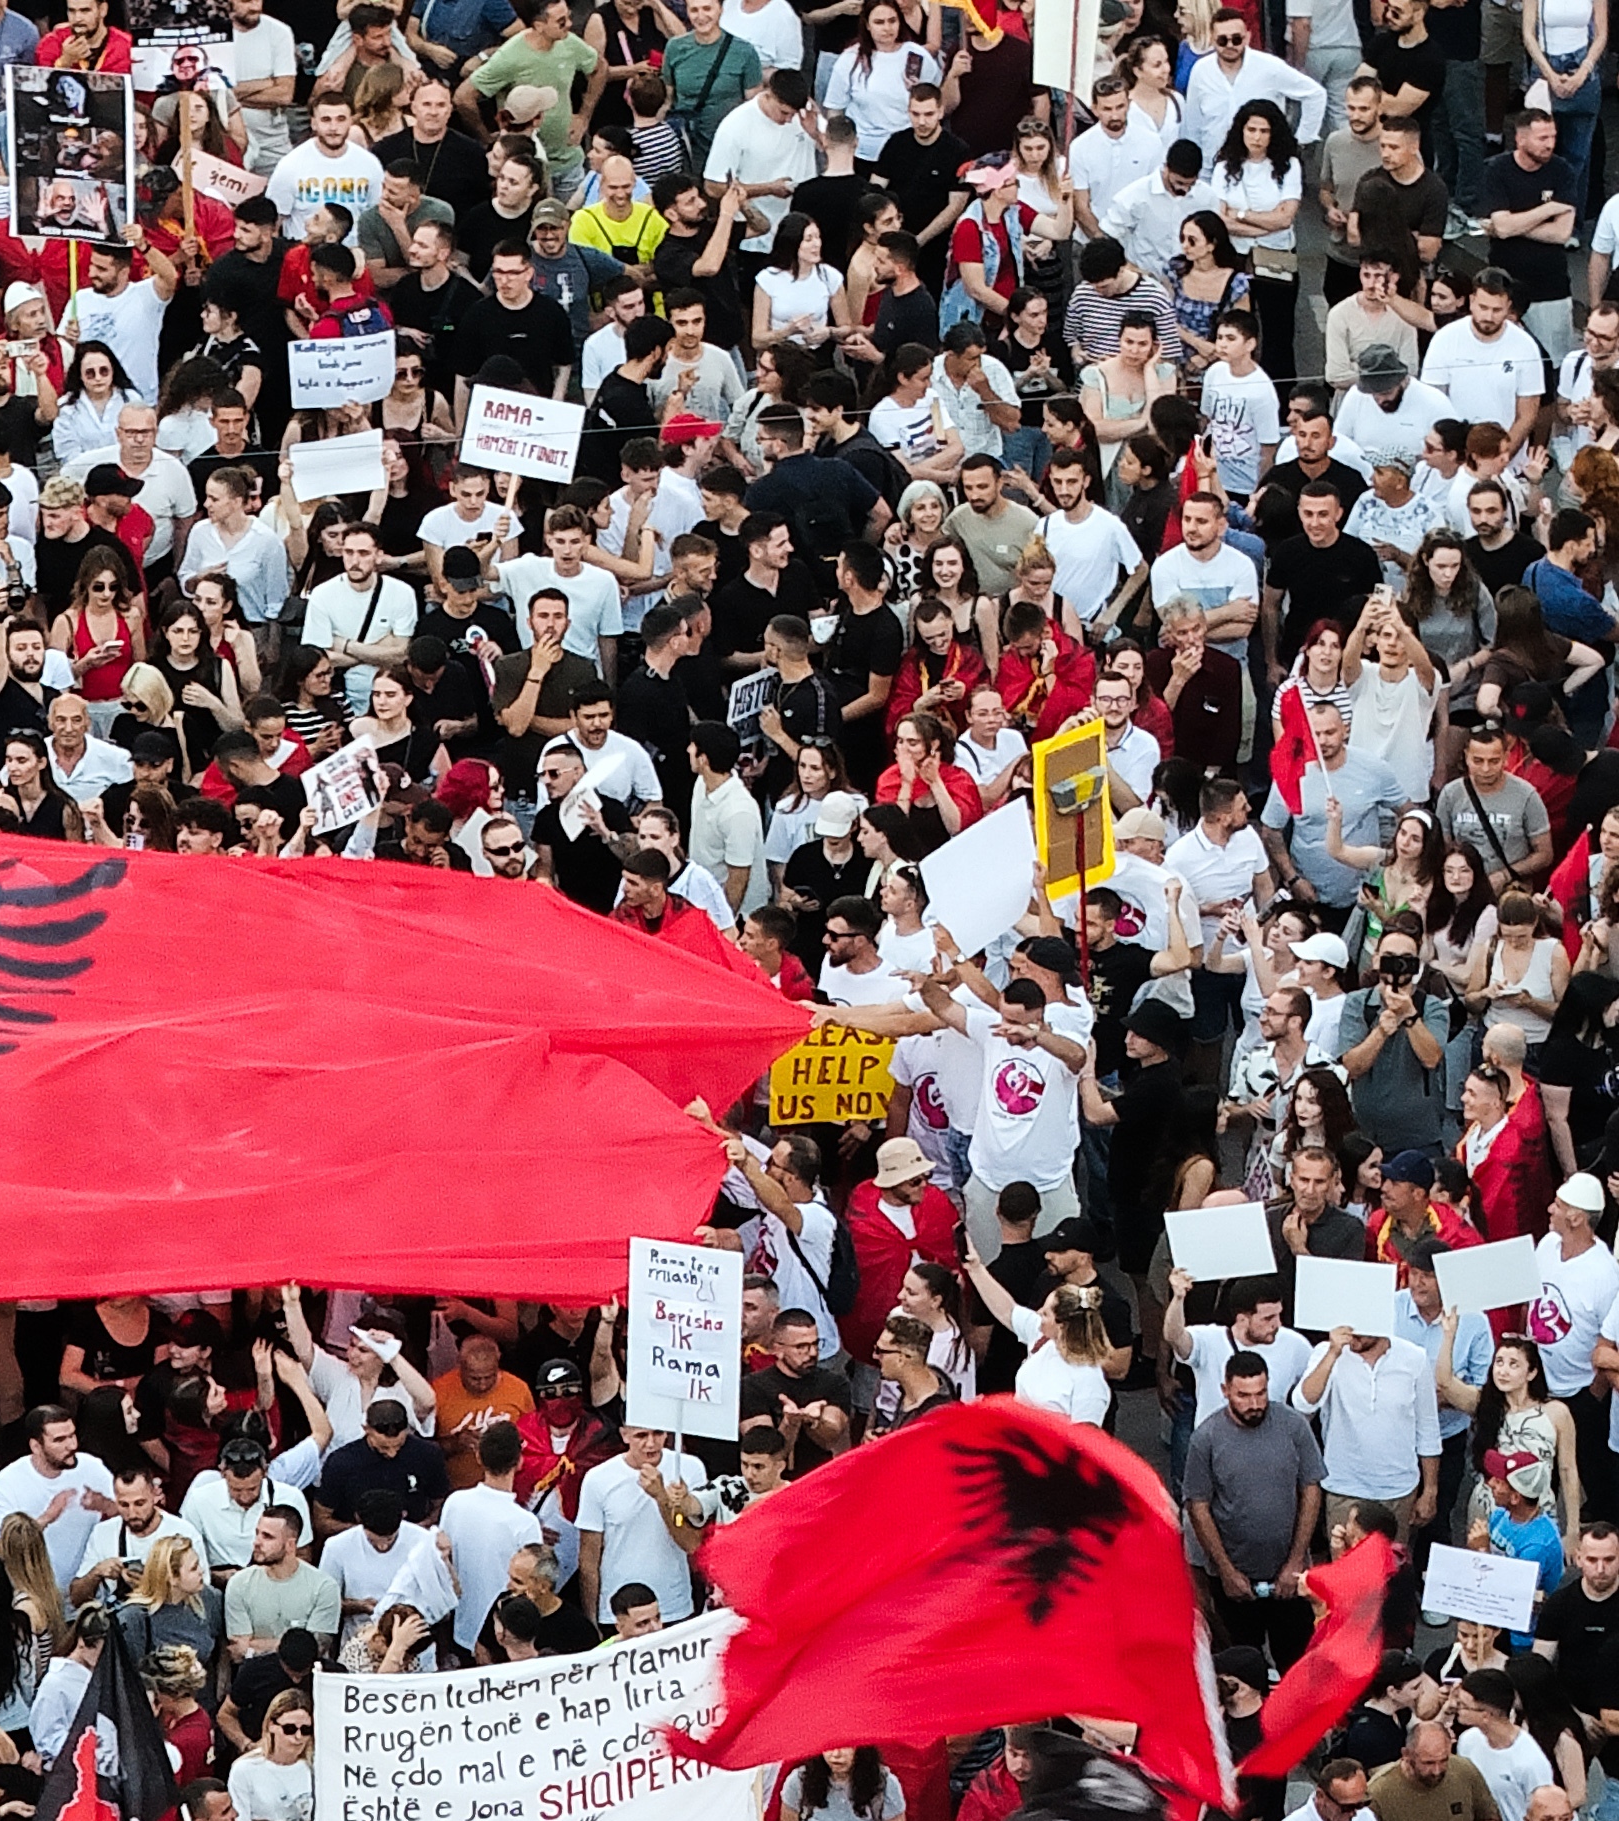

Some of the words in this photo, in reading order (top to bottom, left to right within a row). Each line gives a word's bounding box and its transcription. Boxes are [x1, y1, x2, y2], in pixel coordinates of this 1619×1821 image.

[483, 400, 533, 427] RAMA
[792, 1055, 881, 1086] HELP
[777, 1094, 815, 1121] US
[654, 1299, 723, 1332] Berisha
[651, 1345, 721, 1379] Rama
[344, 1684, 437, 1714] Besën
[550, 1661, 595, 1697] për
[344, 1720, 453, 1763] Rrugën
[462, 1713, 523, 1744] tonë
[535, 1712, 551, 1732] e
[559, 1695, 612, 1727] hap
[344, 1763, 379, 1790] Në
[391, 1756, 444, 1792] çdo
[458, 1750, 506, 1785] mal
[518, 1754, 536, 1779] e
[552, 1740, 588, 1772] në
[434, 1800, 454, 1820] e
